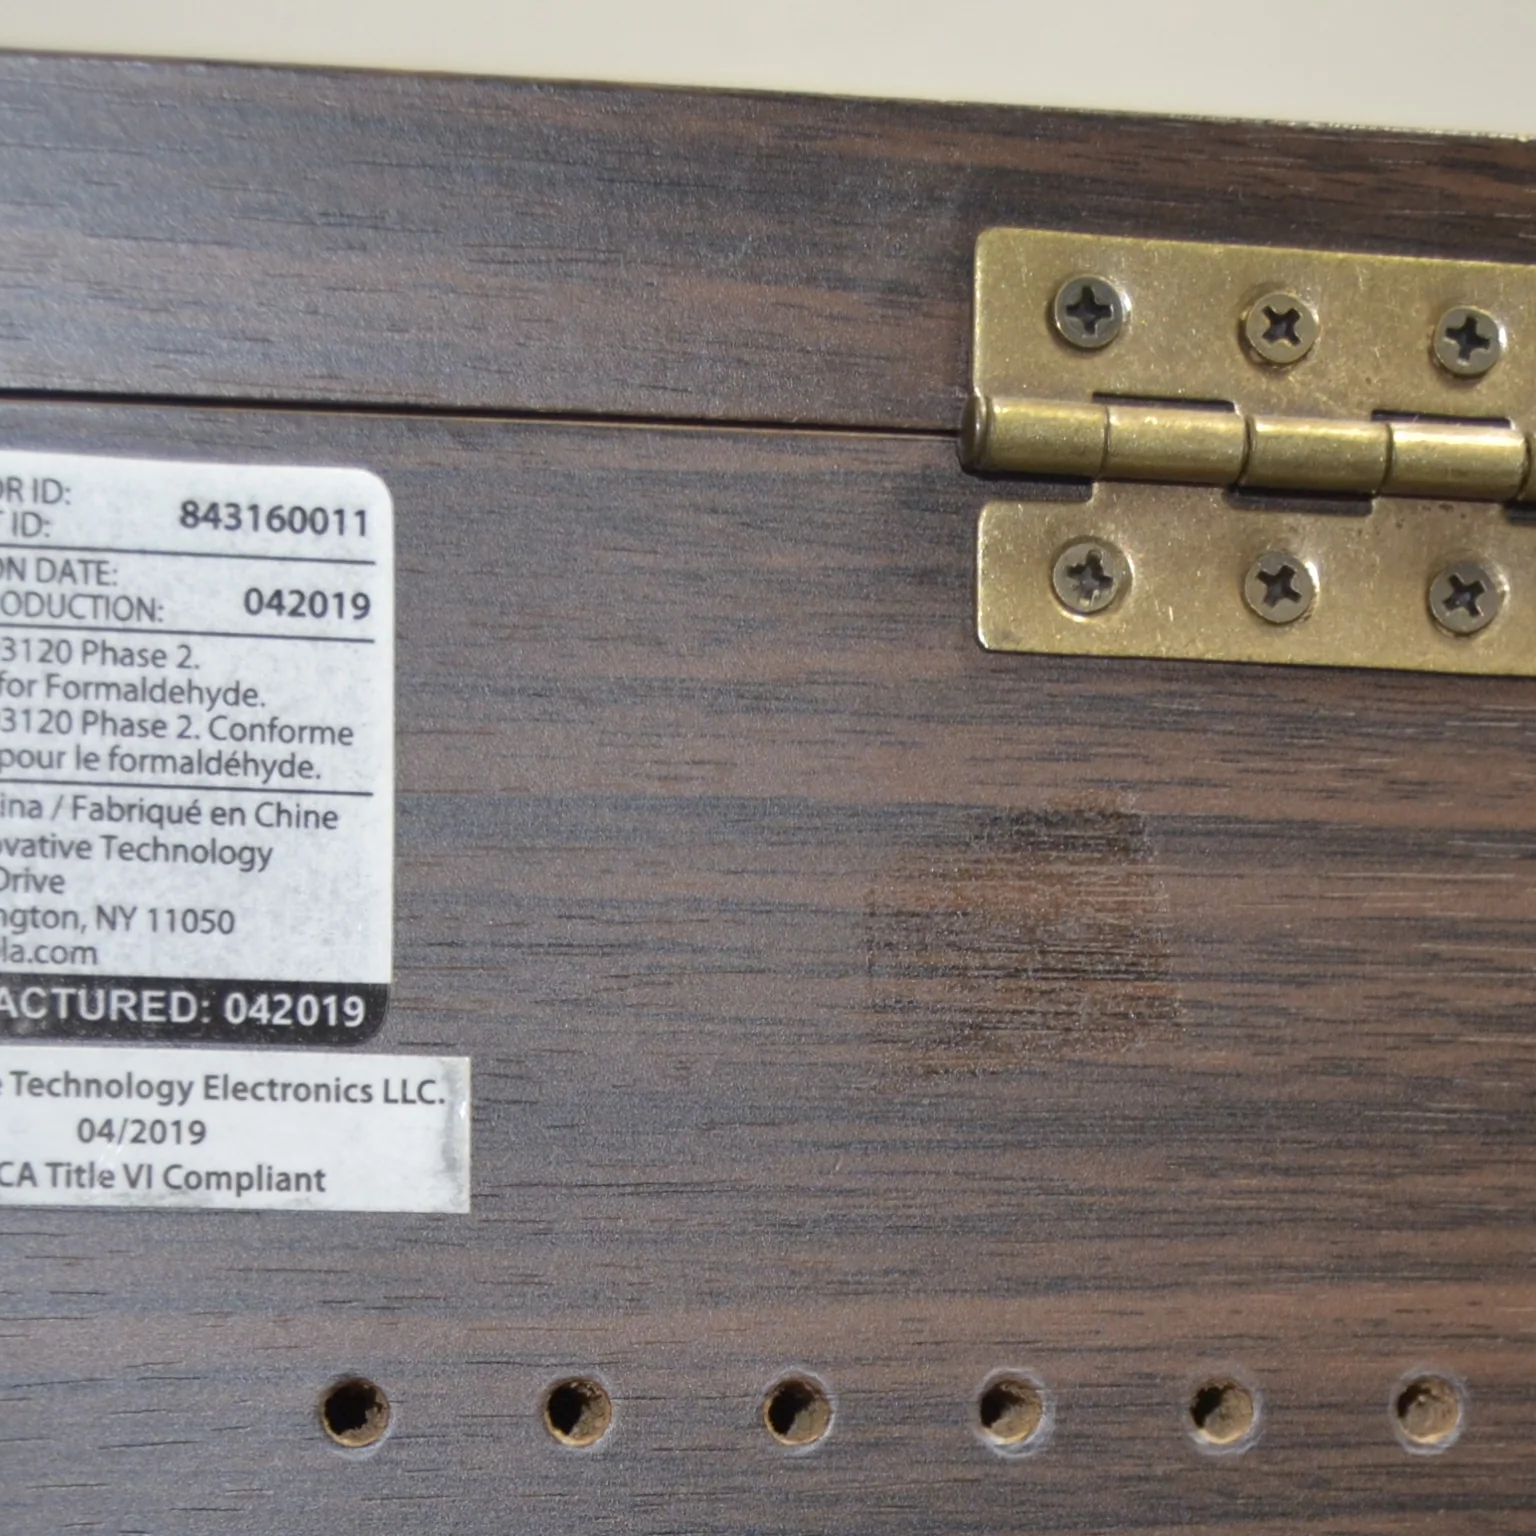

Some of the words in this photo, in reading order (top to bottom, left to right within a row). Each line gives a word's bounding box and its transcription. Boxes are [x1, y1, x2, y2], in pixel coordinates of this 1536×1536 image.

[31, 477, 70, 505] ID:
[11, 510, 51, 538] ID:
[178, 499, 366, 536] 843160011
[35, 556, 117, 586] DATE:
[243, 586, 371, 620] 042019
[81, 638, 168, 668] Phase
[176, 642, 199, 670] 2.
[44, 671, 265, 712] Formaldehyde.
[80, 708, 168, 739] Phase
[176, 713, 200, 740] 2.
[207, 714, 354, 746] Conforme
[74, 743, 100, 772] le
[106, 744, 320, 784] formaldéhyde.
[70, 793, 202, 829] Fabriqué
[208, 805, 246, 826] en
[253, 800, 338, 830] Chine
[100, 833, 272, 873] Technology
[94, 903, 137, 931] NY
[147, 907, 235, 934] 11050
[223, 991, 365, 1027] 042019
[8, 1069, 193, 1107] Technology
[202, 1073, 373, 1103] Electronics
[382, 1077, 445, 1105] LLC.
[76, 1116, 206, 1145] 04/2019
[44, 1160, 115, 1189] Title
[121, 1162, 153, 1189] VI
[161, 1163, 326, 1197] Compliant
